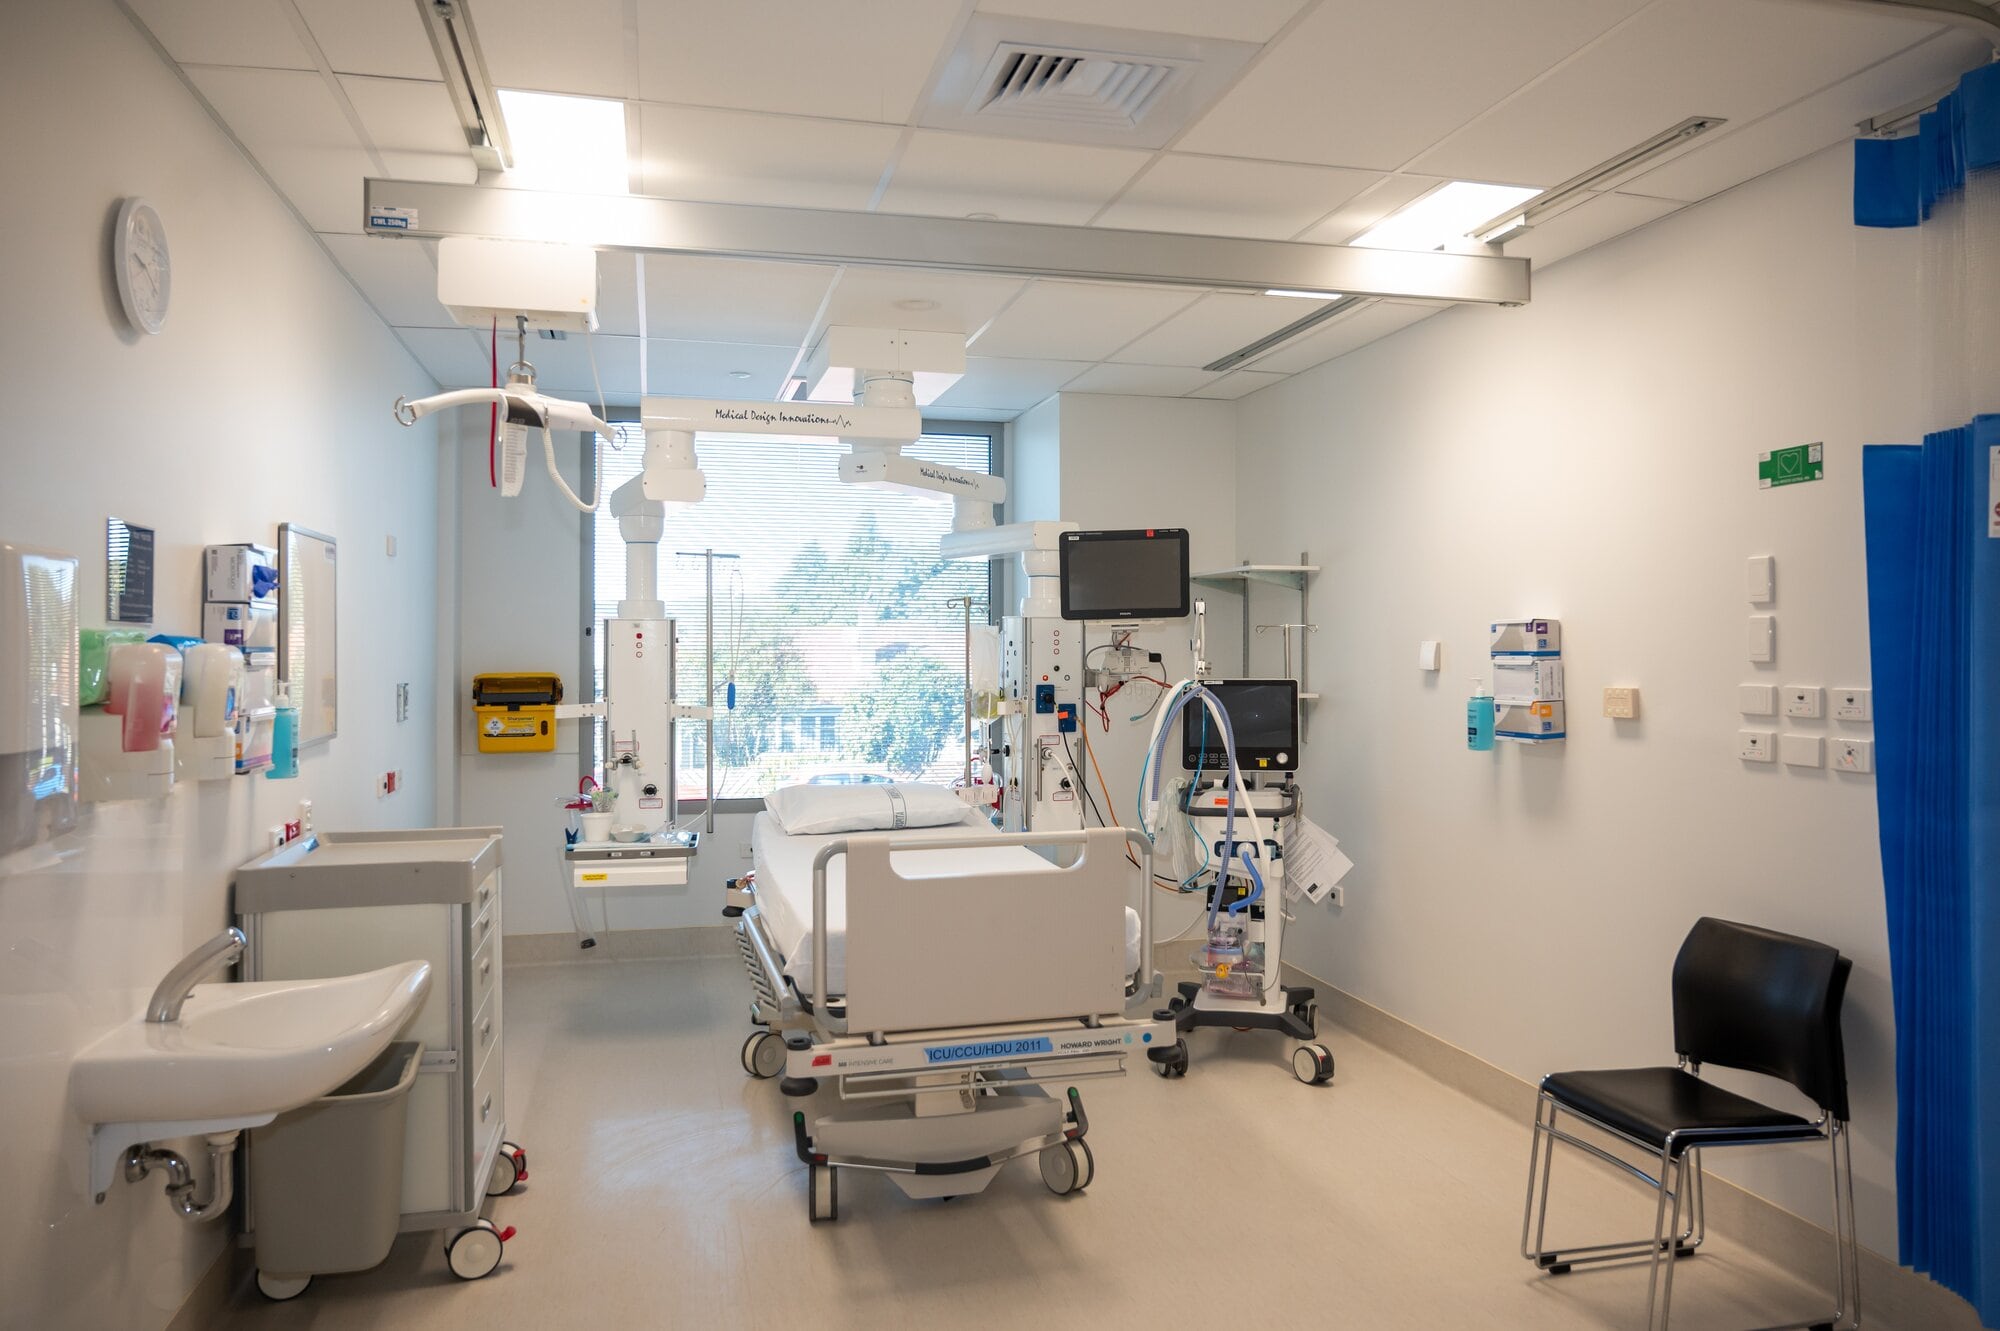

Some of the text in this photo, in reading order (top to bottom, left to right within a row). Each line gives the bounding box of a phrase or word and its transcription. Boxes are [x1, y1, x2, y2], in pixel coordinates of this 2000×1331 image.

[715, 409, 829, 424] Medical Design Innovations
[920, 467, 935, 478] Medical
[929, 1040, 1041, 1060] ICU/CCU/HDU 2011
[1060, 1038, 1122, 1049] HOWARD WRIGHT
